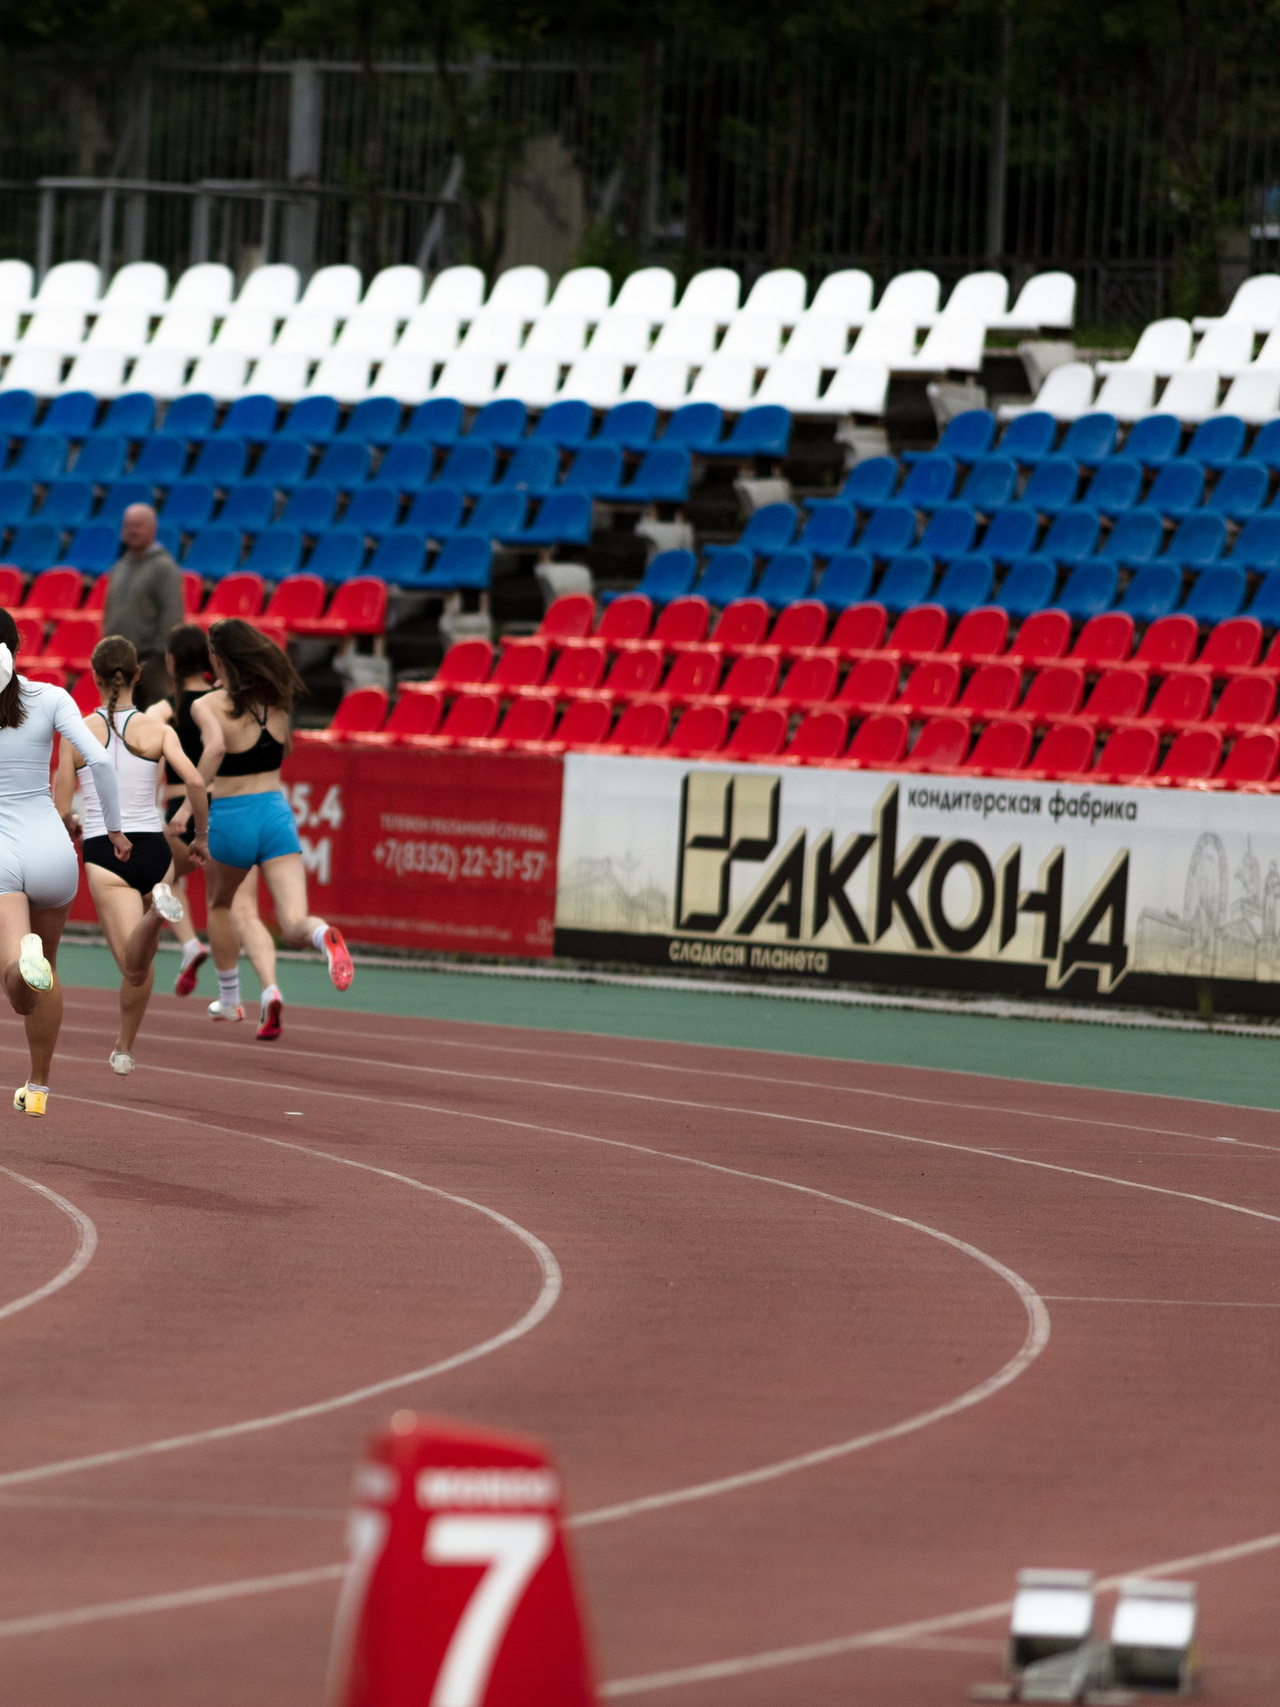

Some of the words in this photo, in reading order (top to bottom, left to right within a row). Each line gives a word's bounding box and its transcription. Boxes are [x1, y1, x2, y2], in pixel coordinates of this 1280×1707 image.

[281, 782, 344, 830] 5.4
[907, 787, 1041, 820] кондитерская
[1048, 788, 1137, 827] фабрика
[373, 837, 460, 882] +7(8352)
[460, 845, 547, 882] 22-31-57
[669, 940, 746, 966] сладкая
[750, 947, 829, 974] планета
[422, 1511, 556, 1707] 7
